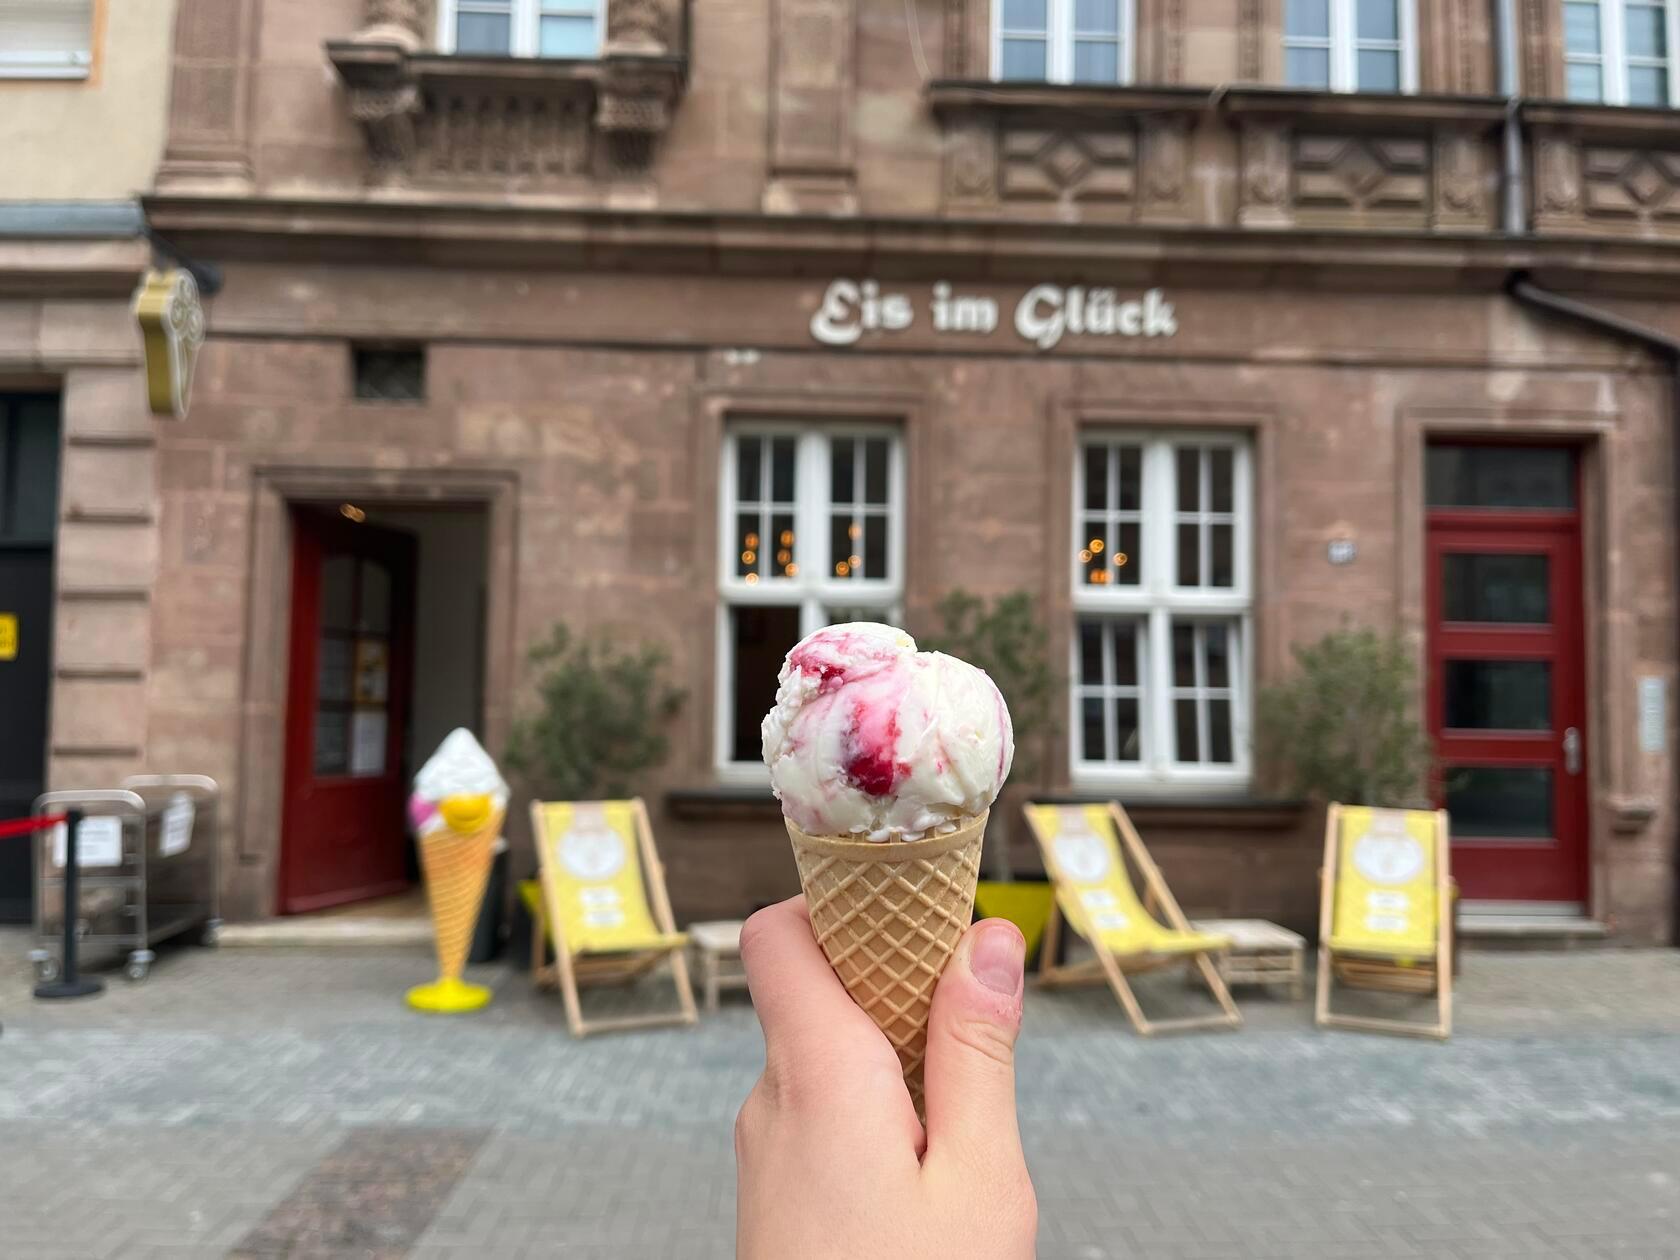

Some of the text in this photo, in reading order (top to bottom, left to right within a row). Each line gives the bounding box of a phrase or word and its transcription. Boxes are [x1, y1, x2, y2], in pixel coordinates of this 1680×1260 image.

[810, 279, 1178, 348] Eis im Glück
